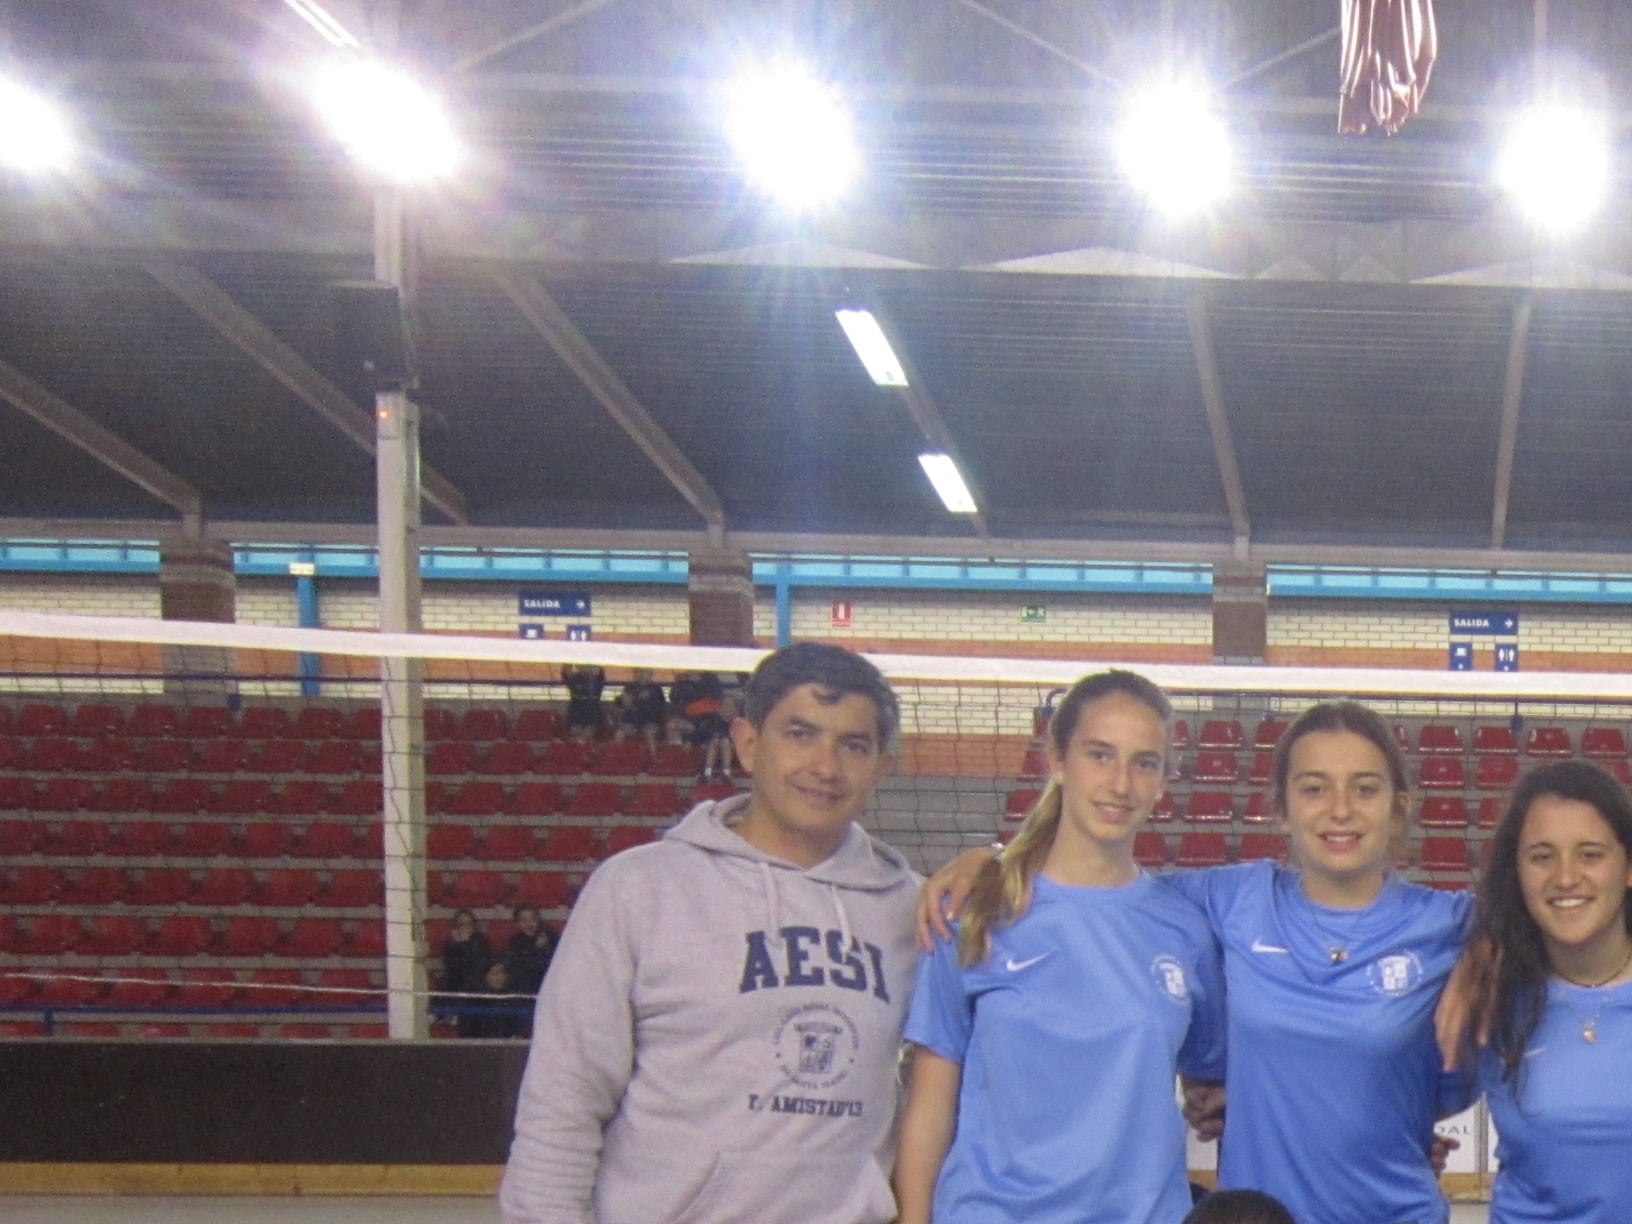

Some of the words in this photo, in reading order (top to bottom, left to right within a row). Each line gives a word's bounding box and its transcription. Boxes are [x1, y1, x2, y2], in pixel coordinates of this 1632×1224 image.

[523, 599, 560, 608] SALIDA
[1454, 618, 1489, 627] SALIDA
[739, 925, 891, 1004] AESI
